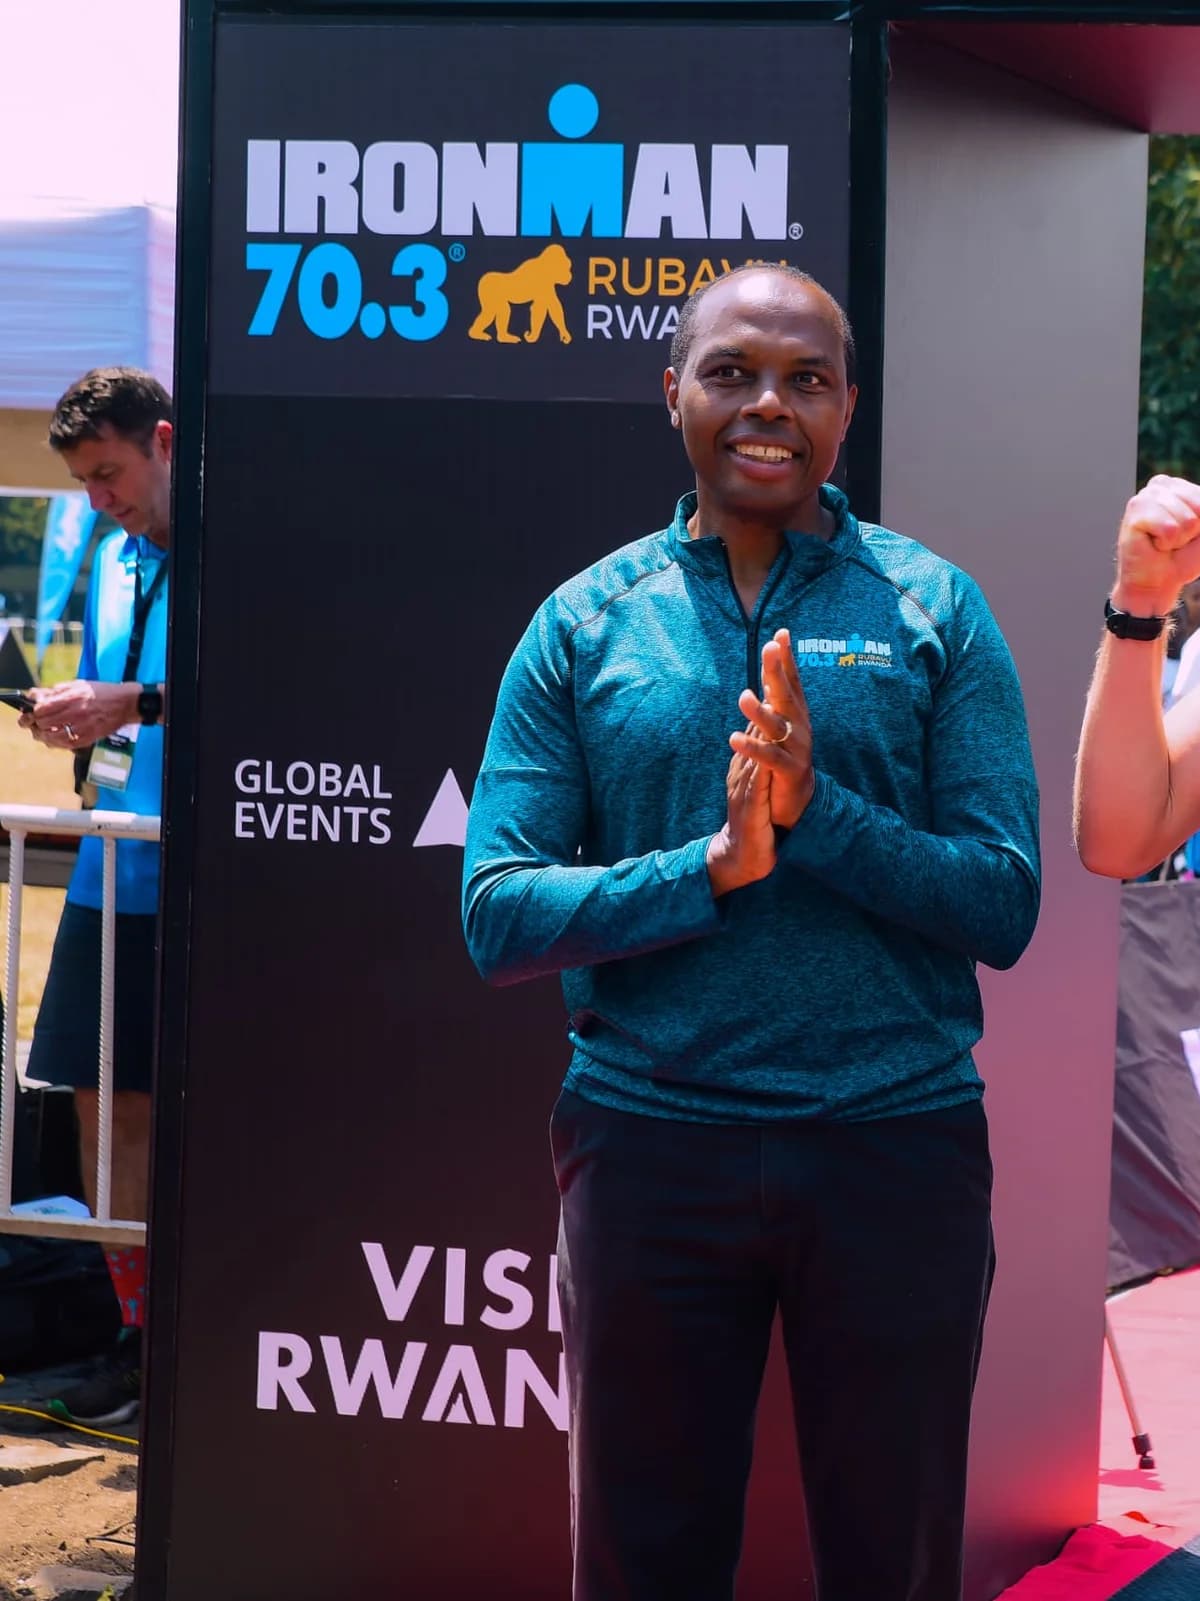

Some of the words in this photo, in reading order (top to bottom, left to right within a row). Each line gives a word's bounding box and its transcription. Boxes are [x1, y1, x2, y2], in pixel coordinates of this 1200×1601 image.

[588, 257, 788, 297] RUBA
[587, 304, 680, 340] RWA
[798, 633, 891, 656] IRONMAN
[799, 653, 835, 667] 70.3
[235, 759, 393, 799] GLOBAL
[235, 801, 392, 844] EVENTS
[361, 1242, 562, 1332] VISI
[256, 1331, 569, 1431] RWAN
